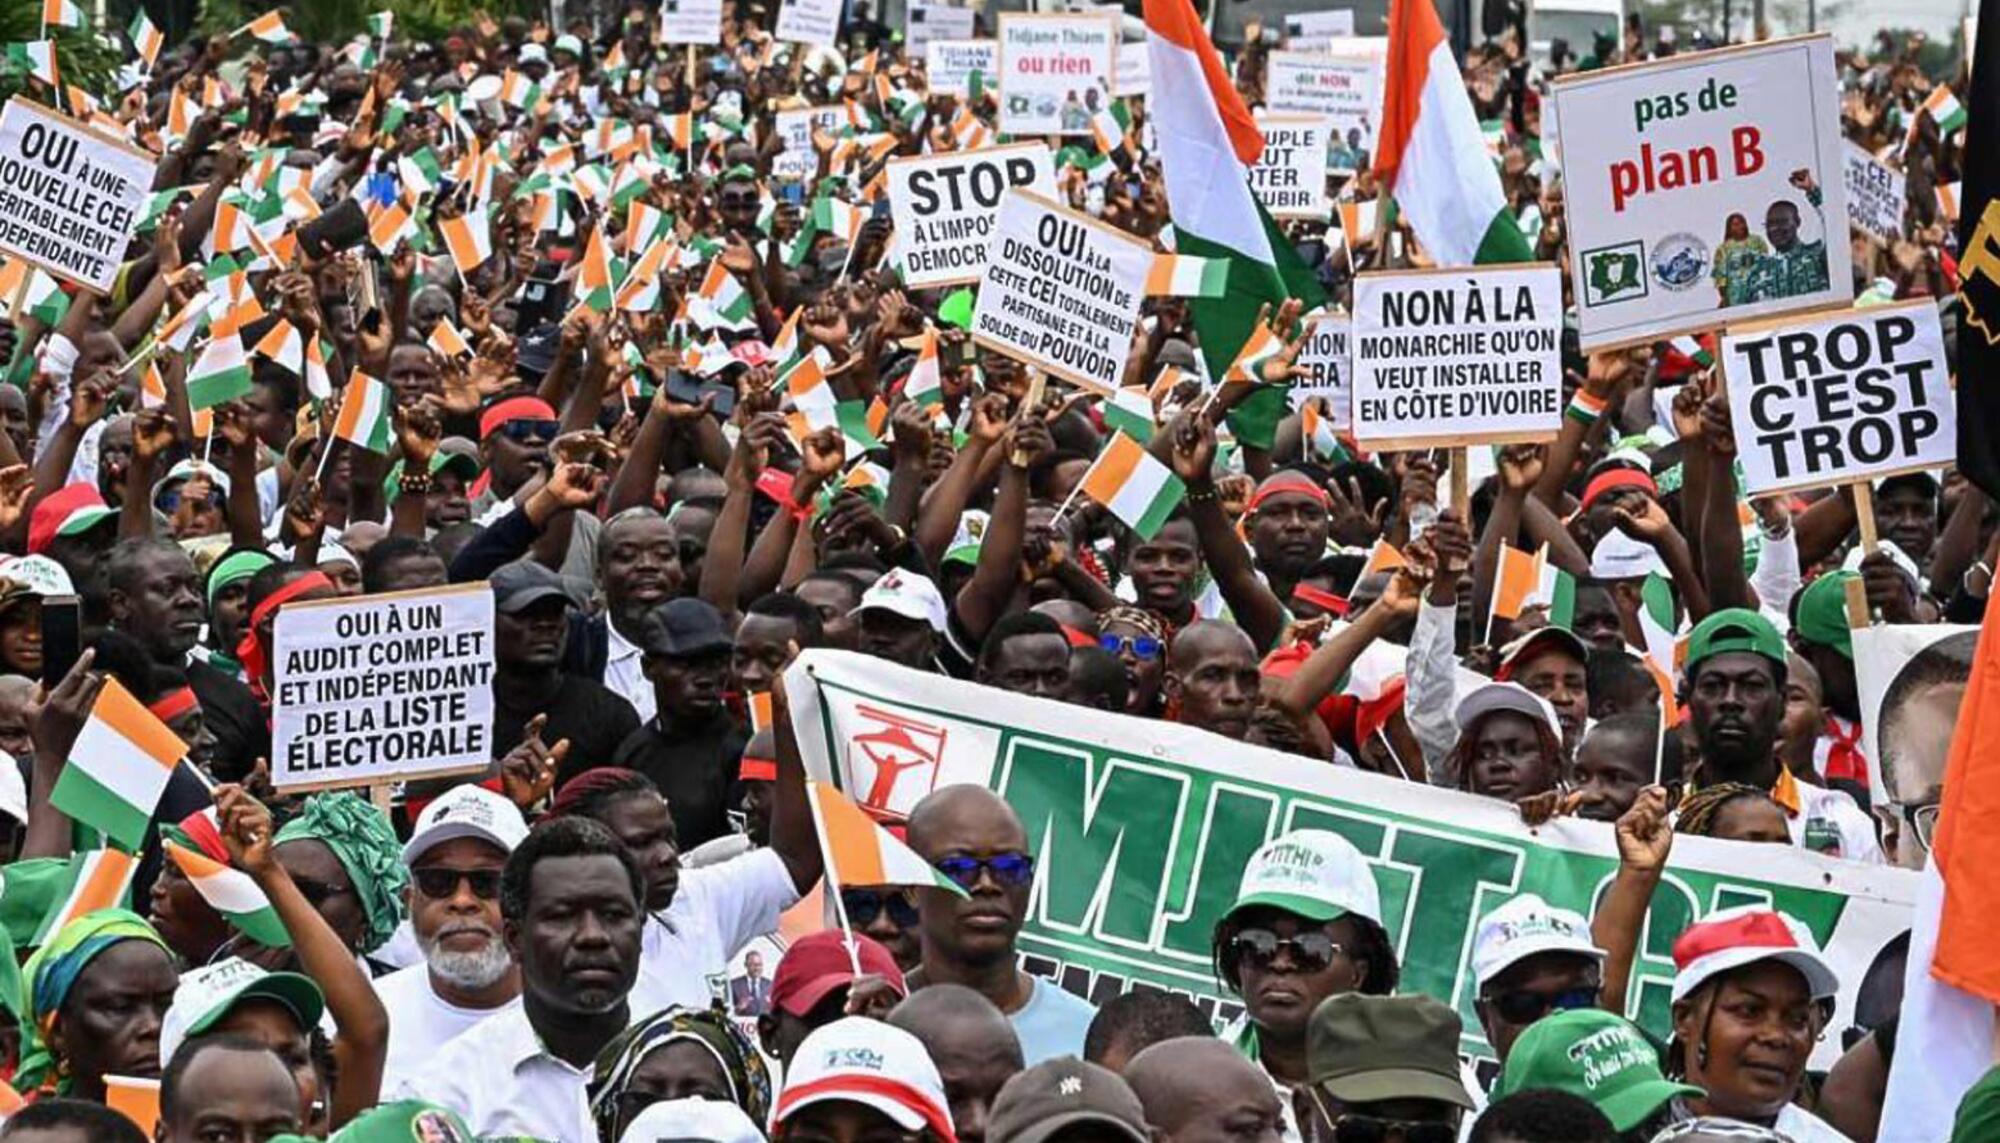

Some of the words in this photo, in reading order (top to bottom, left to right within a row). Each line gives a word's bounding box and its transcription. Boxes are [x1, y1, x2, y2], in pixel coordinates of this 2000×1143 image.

[1062, 27, 1104, 44] Thiam
[1018, 56, 1044, 73] ou
[1049, 52, 1092, 74] rien
[1320, 74, 1350, 88] NON
[1633, 91, 1690, 132] pas
[1698, 77, 1738, 111] de
[20, 122, 79, 175] OUI
[77, 155, 91, 184] À
[90, 166, 127, 199] UNE
[1263, 130, 1315, 147] UPLE
[1263, 148, 1293, 166] UT
[908, 157, 1036, 216] STOP
[1609, 143, 1719, 213] plan
[1731, 125, 1765, 177] B
[0, 185, 117, 256] ÉRITABLEMENT
[96, 200, 133, 235] CEI
[914, 220, 927, 245] À
[907, 243, 992, 273] DÉMOCR
[1038, 213, 1087, 262] OUI
[1095, 254, 1111, 274] LA
[1002, 238, 1115, 304] DISSOLUTION
[1113, 289, 1132, 310] DE
[988, 264, 1028, 294] CETTE
[1028, 275, 1058, 306] CEI
[1058, 293, 1134, 338] TOTALEMENT
[1381, 289, 1455, 328] NON
[1464, 279, 1487, 324] À
[1494, 285, 1536, 323] LA
[1001, 295, 1067, 336] PARTISANE
[1067, 322, 1084, 342] ET
[1095, 335, 1110, 354] LA
[1300, 333, 1345, 356] TION
[1360, 331, 1486, 360] MONARCHIE
[1490, 328, 1555, 357] QU'ON
[979, 313, 1019, 343] SOLDE
[1019, 329, 1039, 350] DU
[1038, 332, 1118, 383] POUVOIR
[1735, 316, 1916, 386] TROP
[1374, 365, 1428, 390] VEUT
[1433, 360, 1543, 387] INSTALLER
[1749, 359, 1934, 432] C'EST
[1360, 398, 1388, 422] EN
[1392, 389, 1455, 421] CÔTE
[1458, 388, 1557, 417] D'IVOIRE
[1756, 409, 1939, 479] TROP
[335, 610, 379, 639] OUI
[386, 603, 402, 633] À
[407, 603, 442, 631] UN
[286, 644, 362, 675] AUDIT
[368, 631, 485, 667] COMPLET
[280, 681, 310, 706] ET
[316, 661, 492, 703] INDÉPENDANT
[305, 710, 339, 737] DE
[344, 707, 376, 733] LA
[383, 692, 467, 729] LISTE
[287, 724, 484, 773] ÉLECTORALE
